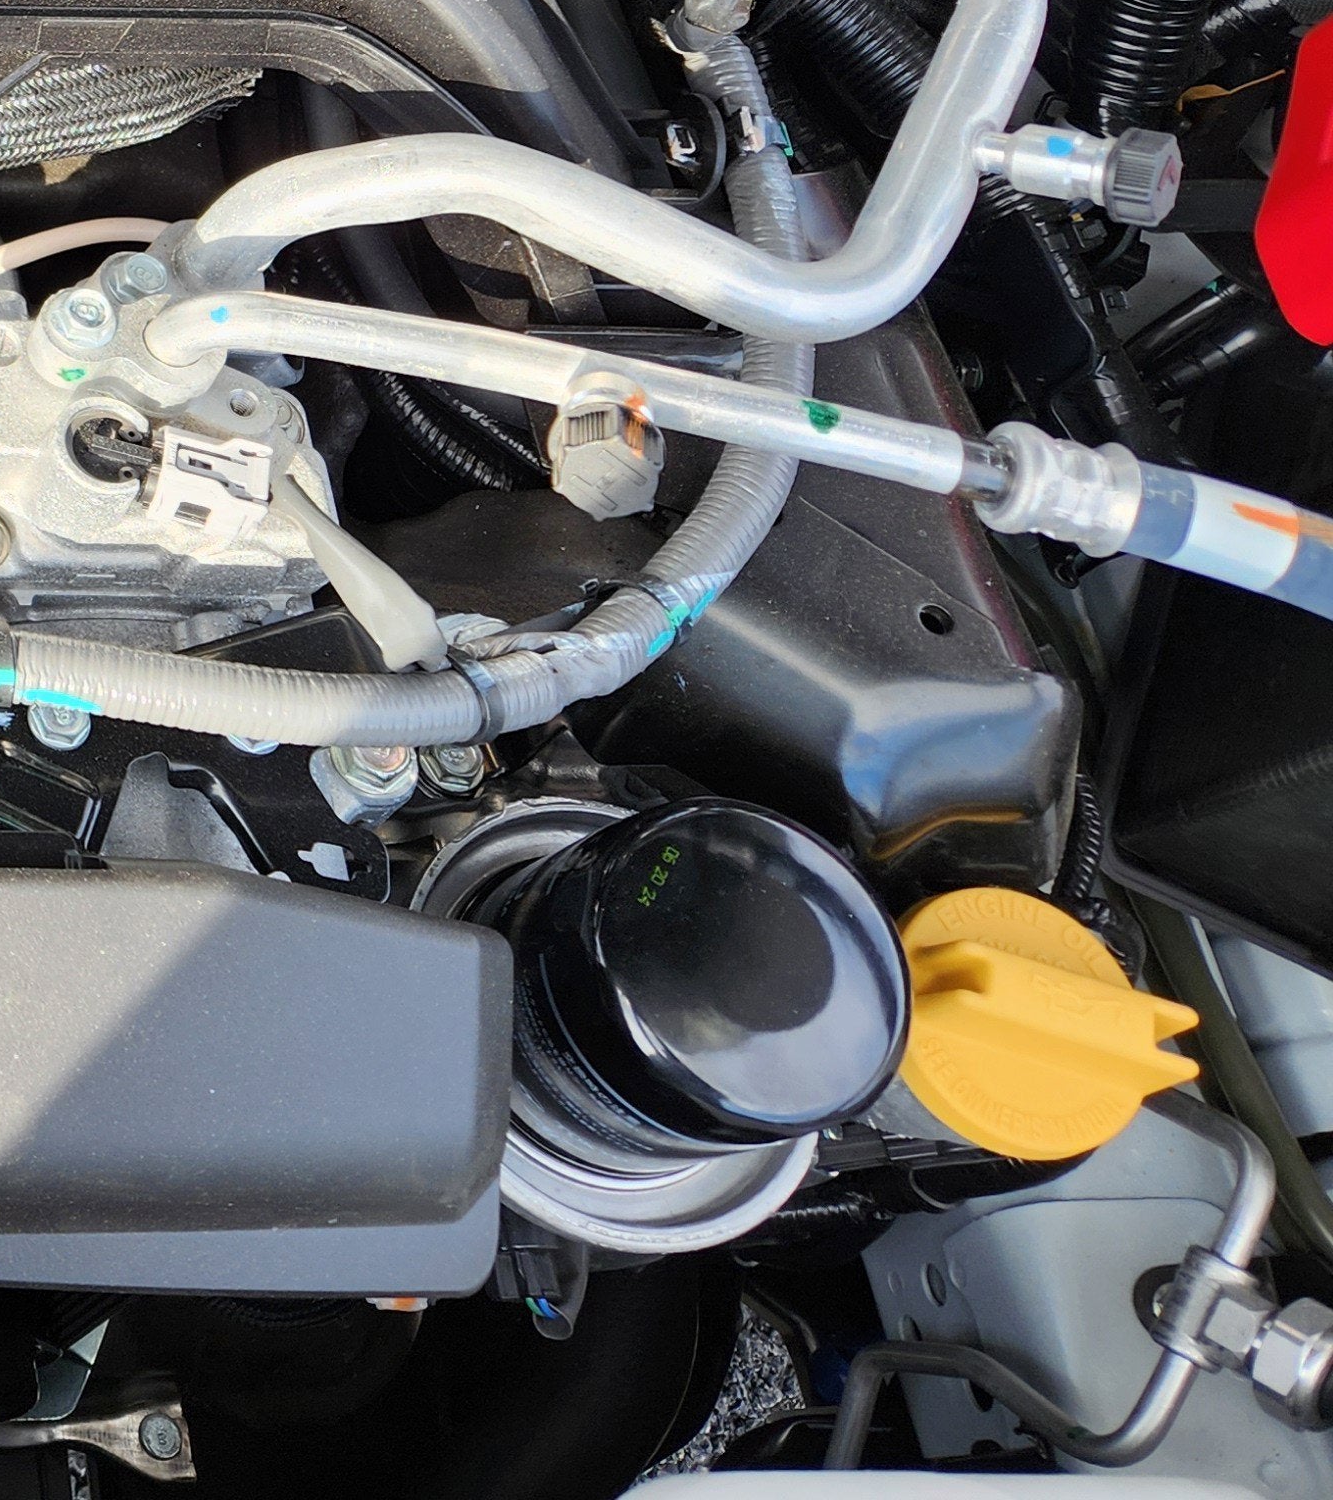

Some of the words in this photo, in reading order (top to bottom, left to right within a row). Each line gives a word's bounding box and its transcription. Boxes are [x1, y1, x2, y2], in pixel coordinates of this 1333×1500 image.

[662, 846, 680, 865] 06
[651, 865, 669, 887] 20
[637, 886, 657, 907] 24
[936, 891, 1051, 932] ENGINE
